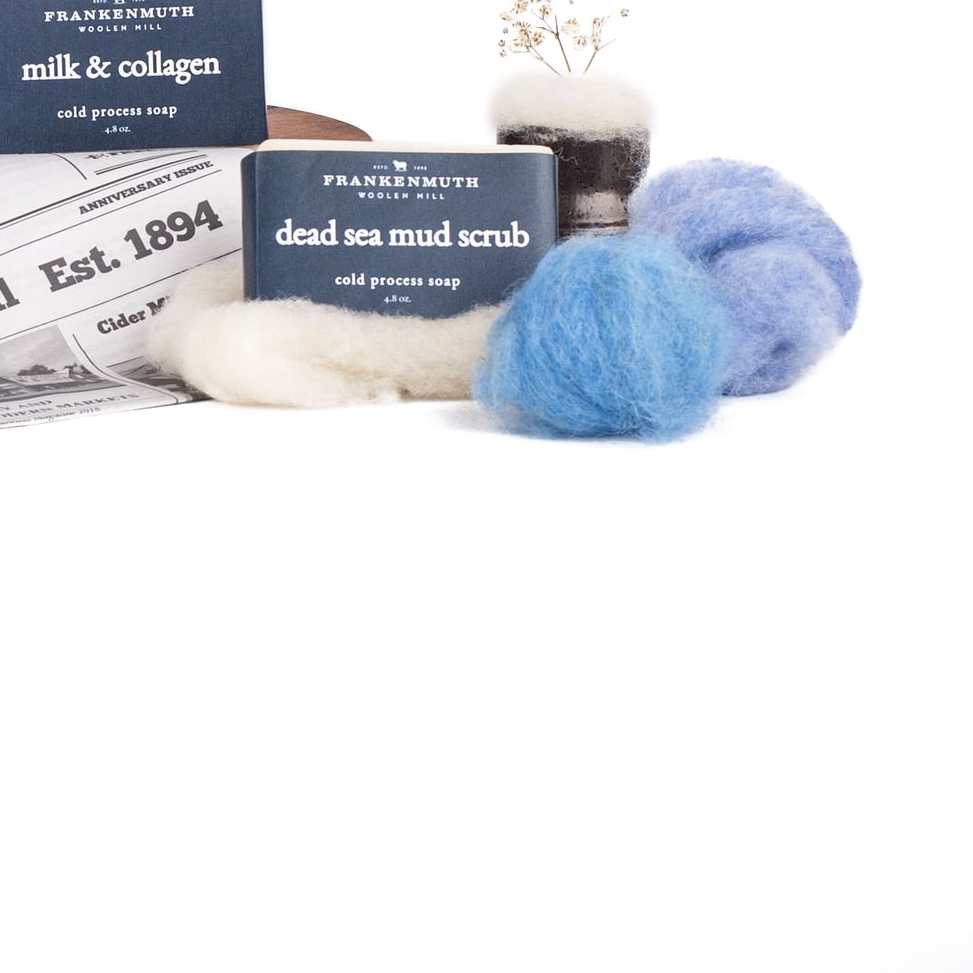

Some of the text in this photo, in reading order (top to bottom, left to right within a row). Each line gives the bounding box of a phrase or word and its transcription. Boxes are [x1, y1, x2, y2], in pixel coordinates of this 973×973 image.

[44, 6, 195, 22] FRANKENMUTH
[78, 23, 162, 33] WOOLEN MILL
[21, 50, 221, 85] milk & collagen
[57, 105, 178, 121] cold process soap
[104, 125, 117, 135] 4.8
[78, 160, 214, 215] ANNIVERSARY ISSUE
[323, 174, 479, 188] FRANKENMUTH
[358, 191, 444, 200] WOOLEN MILL
[275, 218, 530, 247] dead sea mud scrub
[38, 246, 121, 293] Est.
[124, 199, 223, 260] 1894
[335, 273, 461, 290] cold process soap
[383, 294, 397, 304] 4.8
[96, 308, 146, 334] Cider
[18, 399, 54, 409] AND
[56, 393, 140, 409] MARKETS
